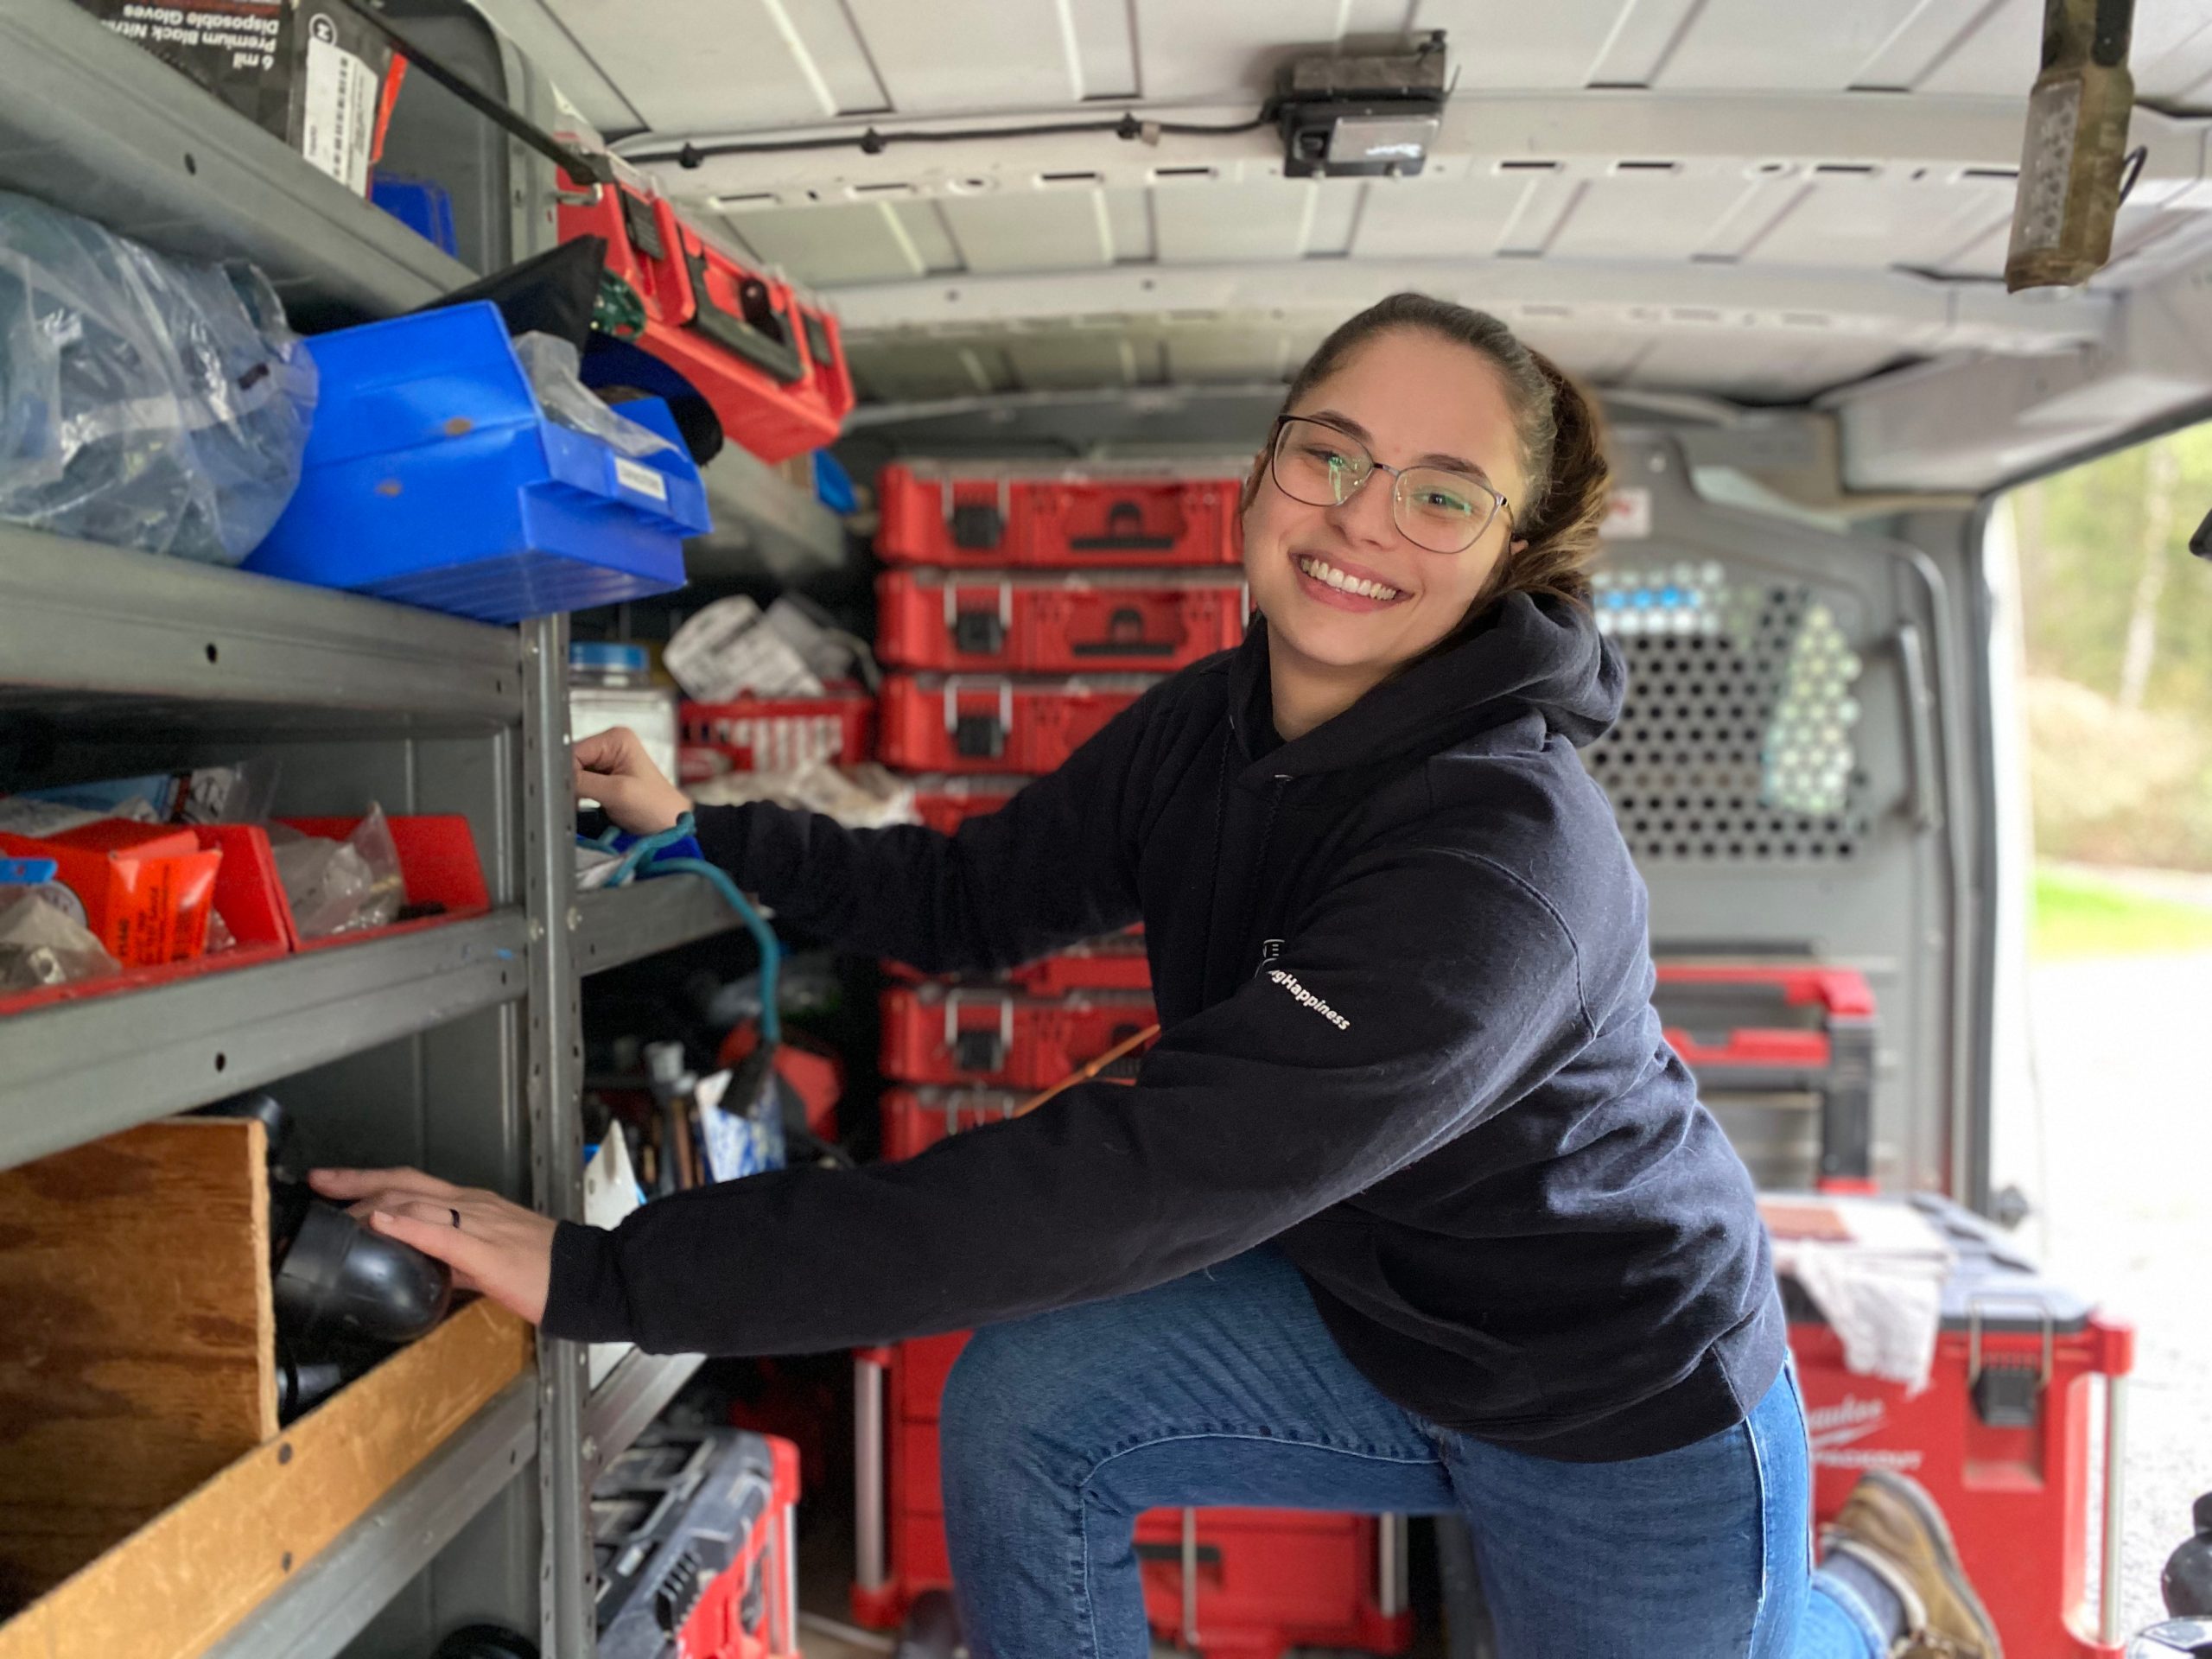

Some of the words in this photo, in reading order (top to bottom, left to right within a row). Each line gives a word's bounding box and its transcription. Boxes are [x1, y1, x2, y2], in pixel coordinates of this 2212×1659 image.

[123, 4, 184, 26] Gloves
[186, 11, 280, 35] Disposable
[151, 24, 200, 46] Black
[202, 31, 277, 54] Premium
[232, 52, 259, 69] mil
[262, 54, 274, 71] 6
